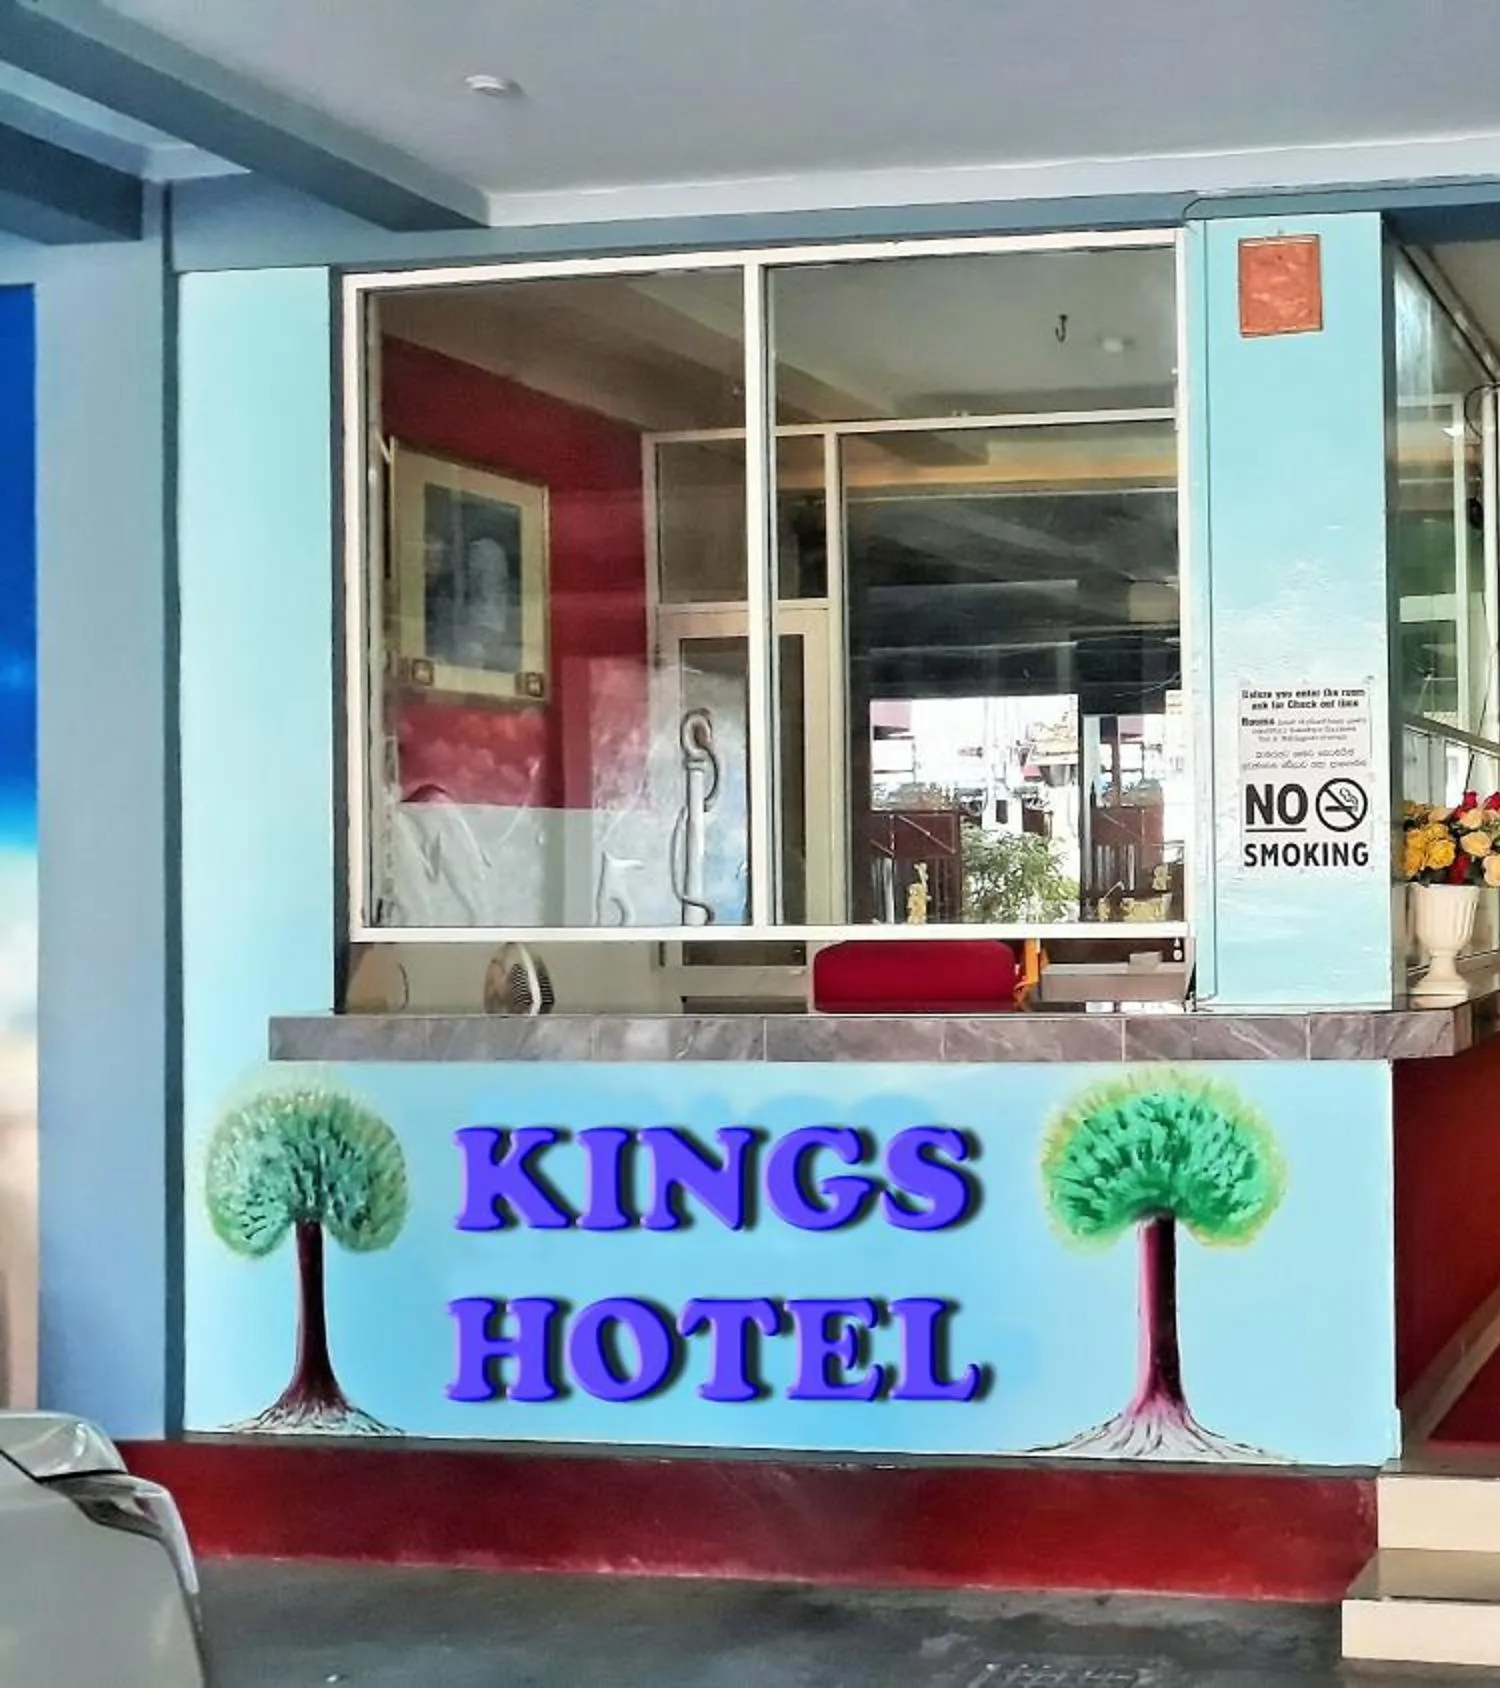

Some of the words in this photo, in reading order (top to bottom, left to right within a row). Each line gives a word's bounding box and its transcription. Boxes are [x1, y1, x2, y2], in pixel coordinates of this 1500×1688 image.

[1245, 783, 1308, 825] NO
[1244, 841, 1369, 867] SMOKING
[453, 1126, 974, 1232] KINGS
[446, 1297, 986, 1402] HOTEL
